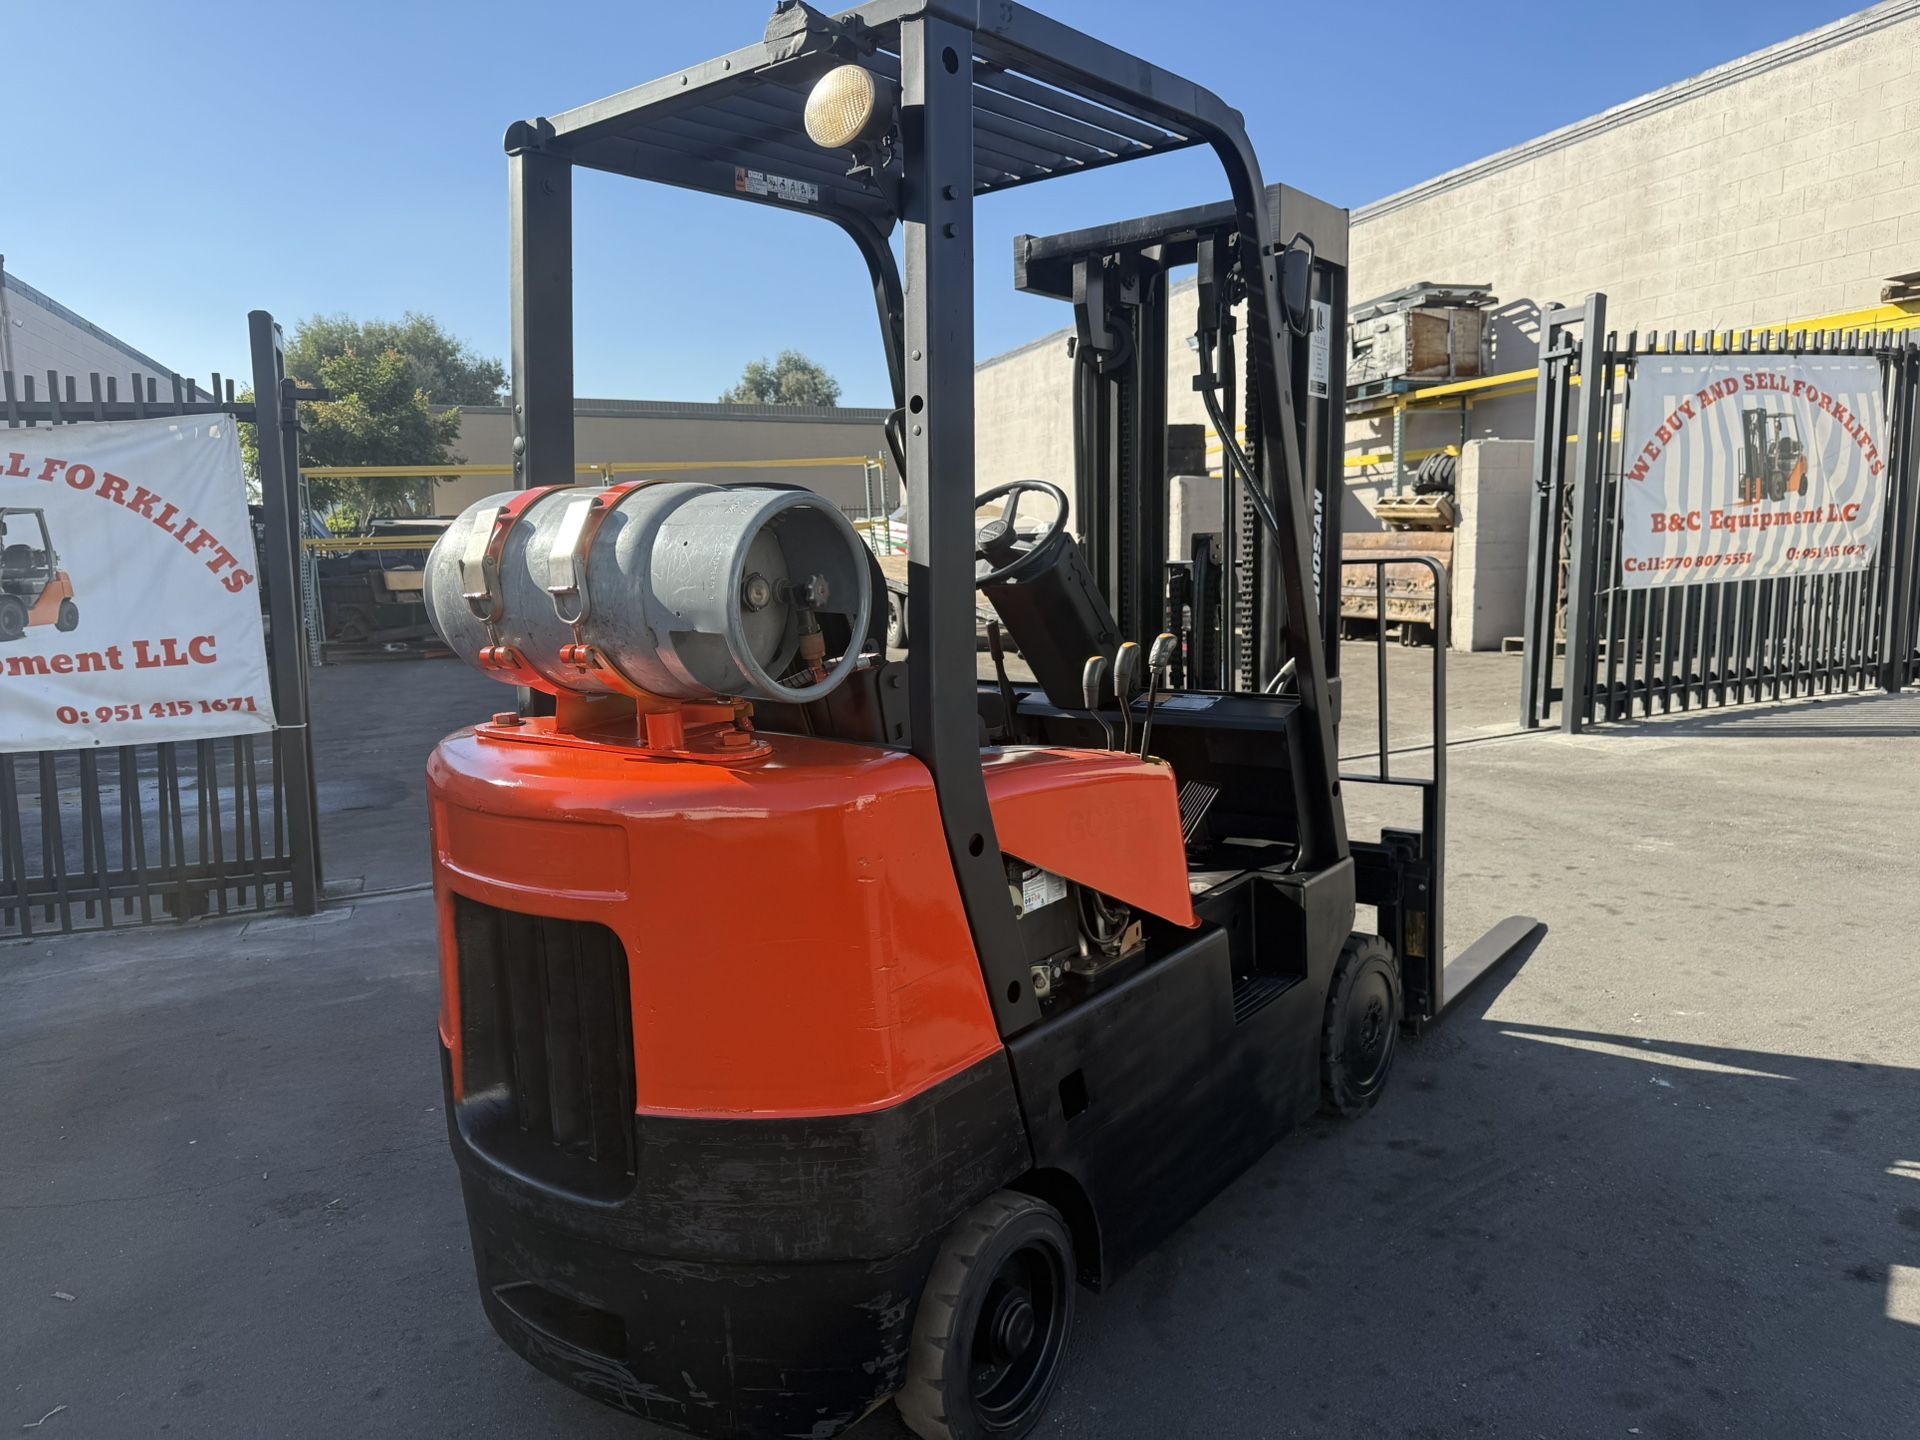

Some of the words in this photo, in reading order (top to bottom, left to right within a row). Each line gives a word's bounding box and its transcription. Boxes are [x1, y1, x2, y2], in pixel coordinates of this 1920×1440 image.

[1627, 440, 1661, 482] WE
[1655, 400, 1696, 446] BUY
[1696, 377, 1739, 409] AND
[1743, 373, 1789, 392] SELL
[1793, 379, 1885, 476] FORKLIFTS
[0, 452, 31, 477] L
[37, 457, 255, 593] FORKLIFTS
[1651, 511, 1701, 533] B&C
[1710, 506, 1823, 532] Equipment
[1313, 488, 1322, 616] OOSAN
[1695, 555, 1722, 567] 807
[1723, 553, 1752, 566] 5551
[1803, 547, 1821, 559] 951
[0, 646, 124, 676] ment
[132, 635, 217, 669] LLC
[56, 705, 90, 725] O:
[95, 703, 142, 723] 951
[149, 701, 193, 718] 415
[198, 696, 257, 713] 1671
